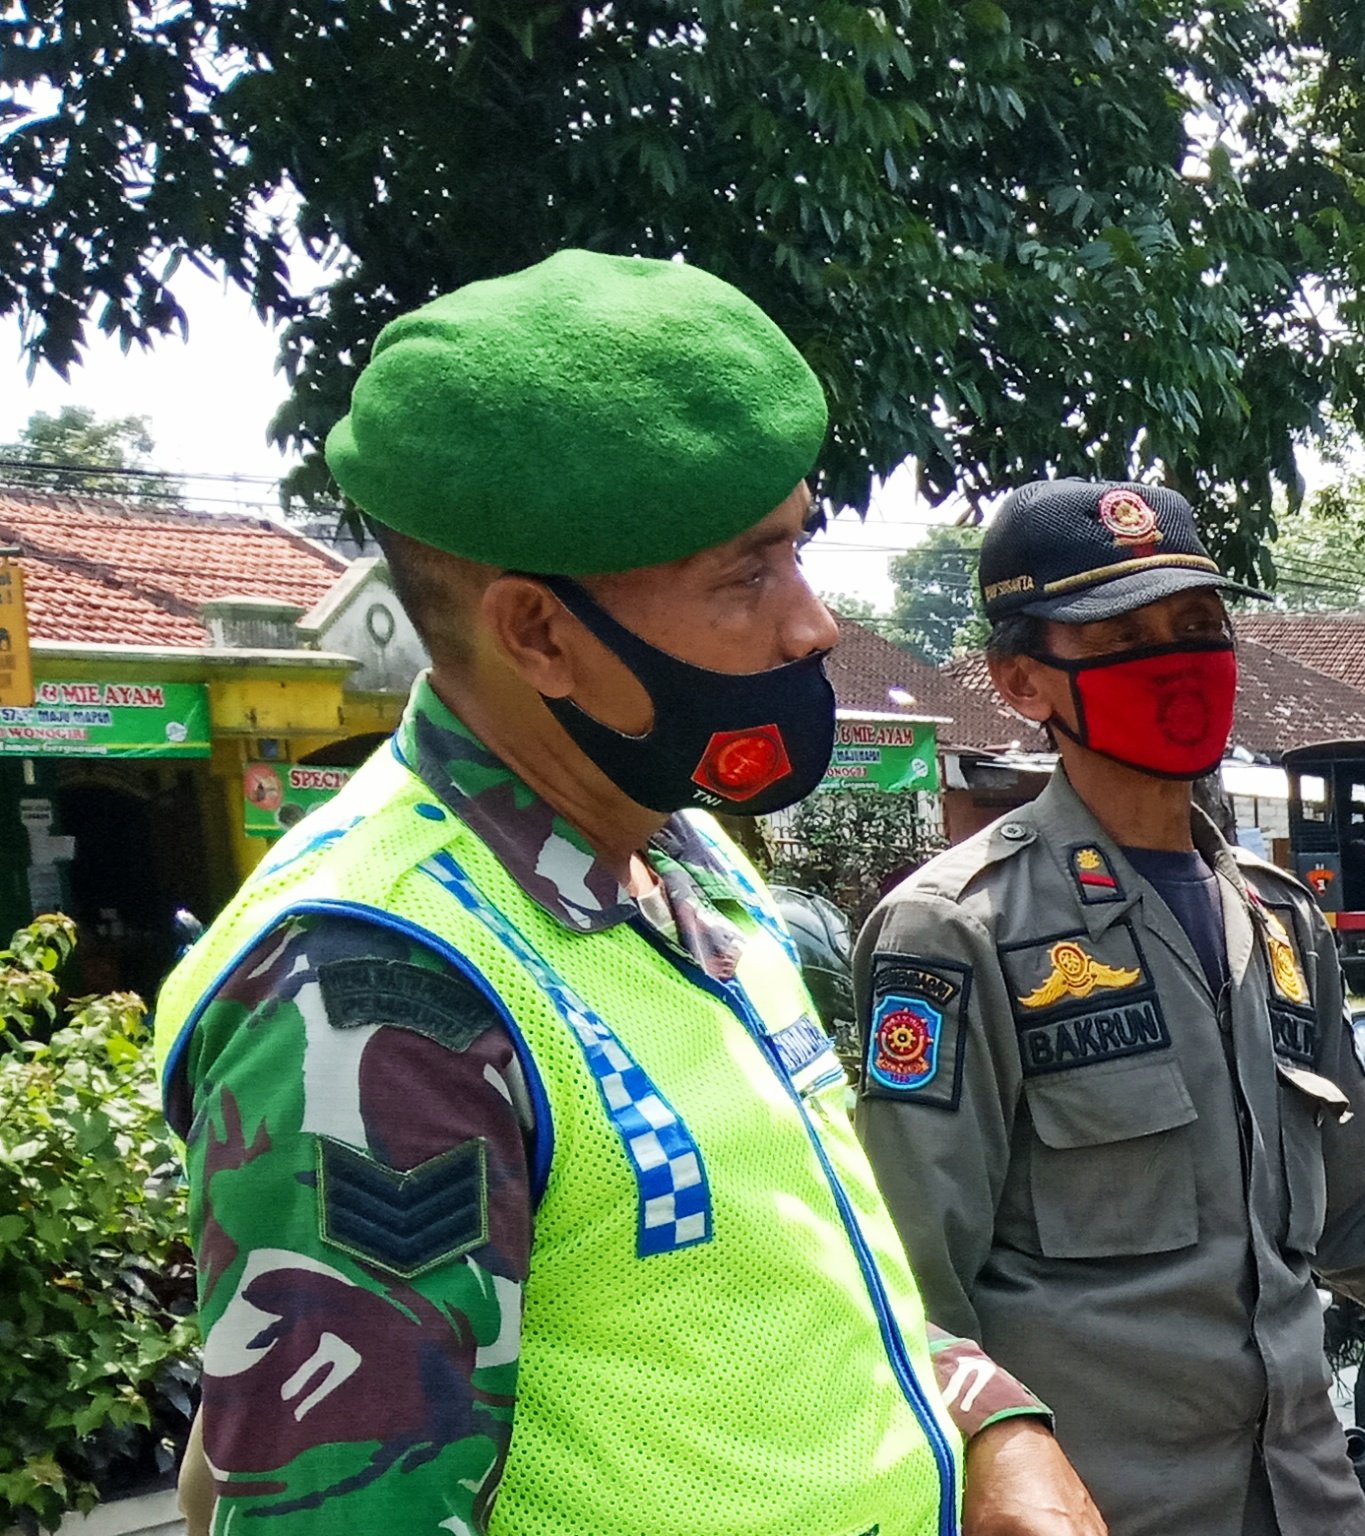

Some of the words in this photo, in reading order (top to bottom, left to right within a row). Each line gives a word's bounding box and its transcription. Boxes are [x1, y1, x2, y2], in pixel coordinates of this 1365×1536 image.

[62, 685, 100, 704] MIE
[105, 686, 165, 706] AYAM
[853, 727, 875, 743] MIE
[876, 728, 913, 745] AYAM
[290, 769, 349, 788] SPECI
[692, 789, 722, 806] TNI
[1028, 1004, 1159, 1065] BAKRUN
